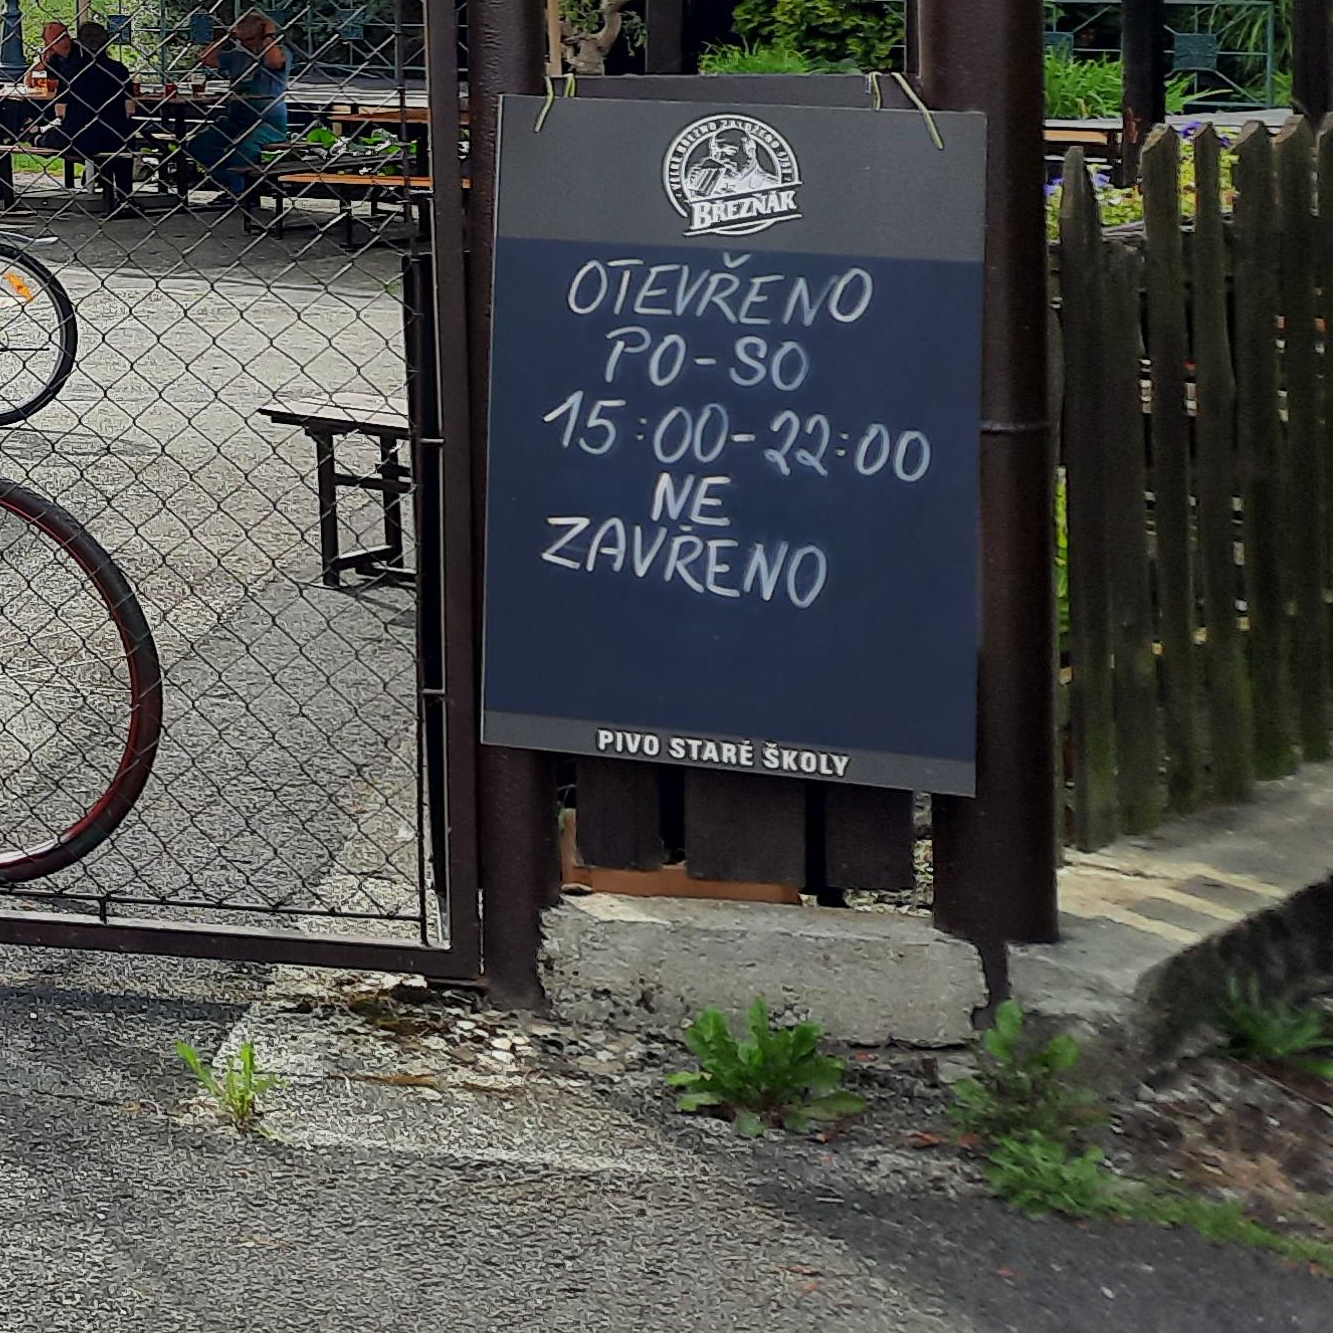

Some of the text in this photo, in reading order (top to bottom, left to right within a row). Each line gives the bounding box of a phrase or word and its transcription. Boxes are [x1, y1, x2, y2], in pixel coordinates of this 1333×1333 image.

[567, 251, 873, 326] OTEVŘENO
[649, 472, 732, 528] NE
[541, 516, 828, 610] ZAVŘENO
[597, 728, 851, 778] PIVO STARÉ ŠKOLY
